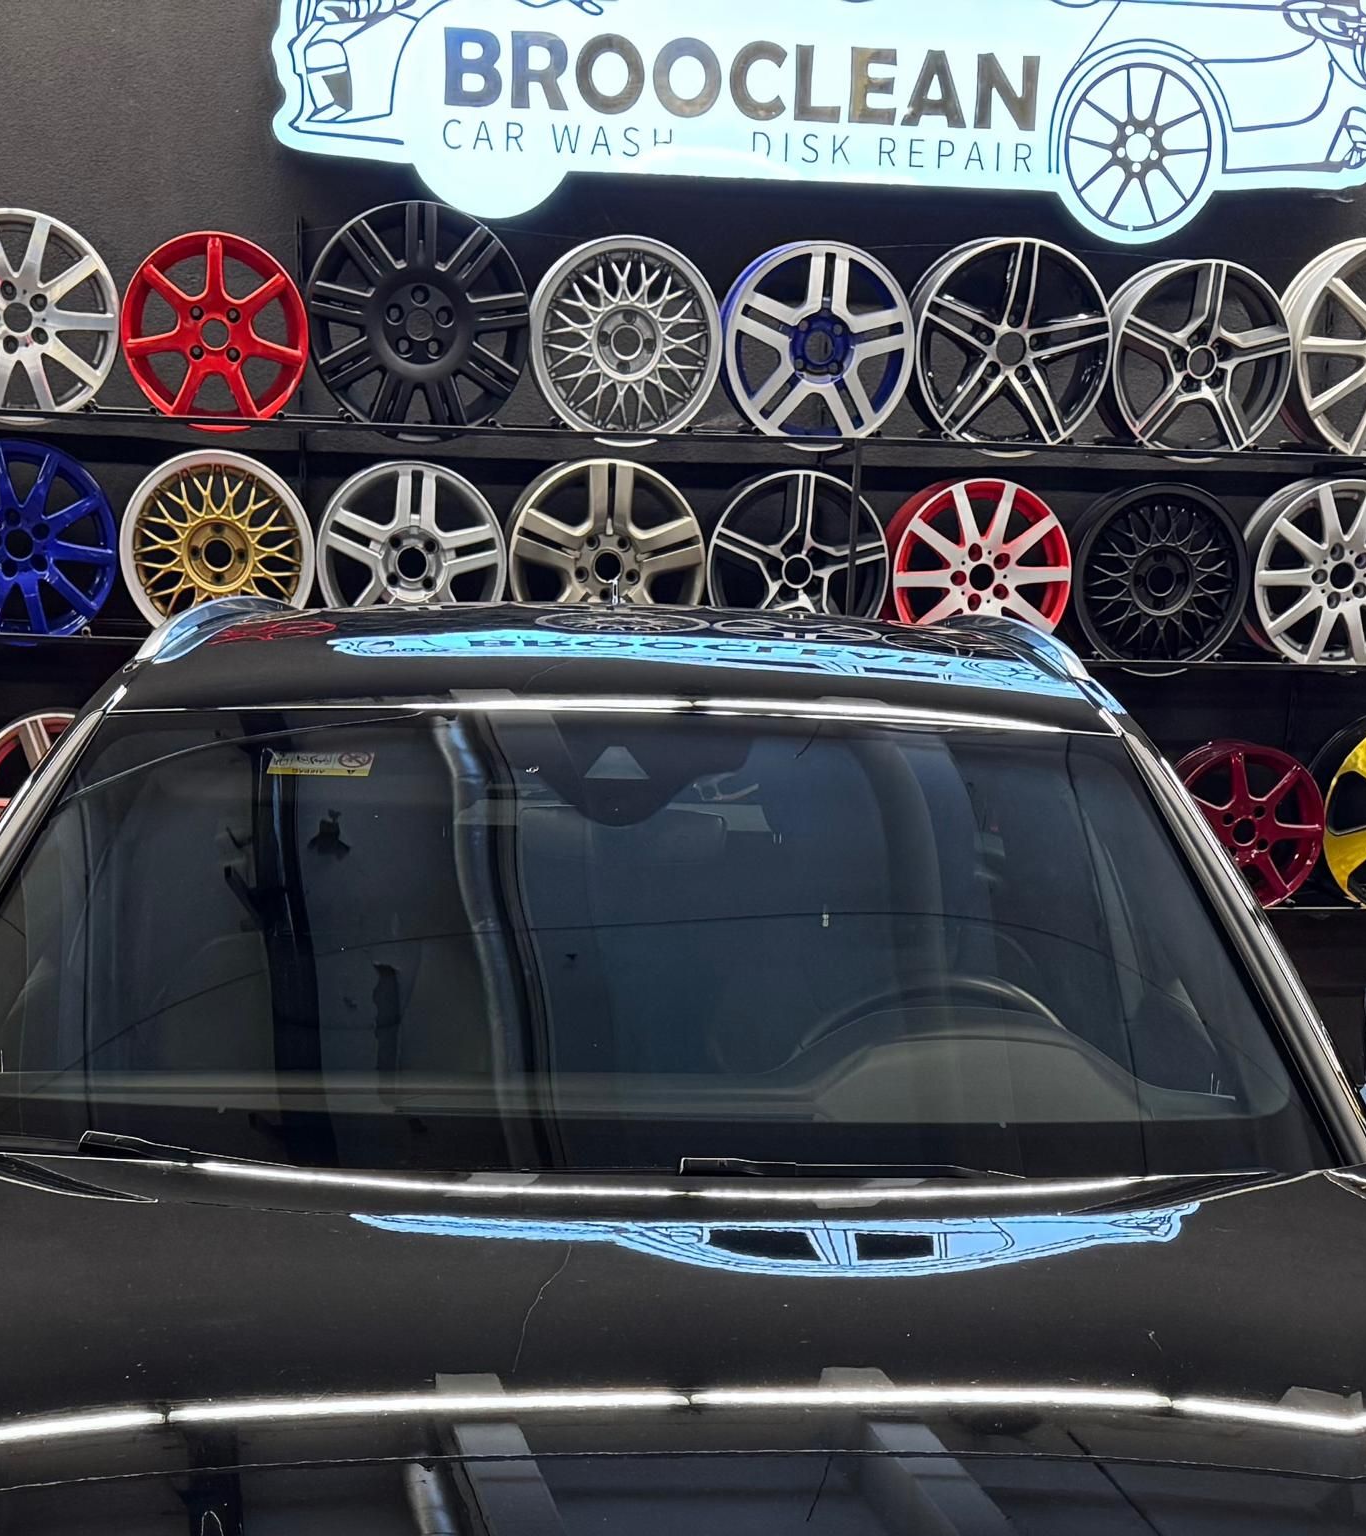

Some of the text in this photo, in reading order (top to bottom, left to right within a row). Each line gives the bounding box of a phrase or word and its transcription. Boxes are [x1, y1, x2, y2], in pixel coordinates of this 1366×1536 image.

[443, 26, 1041, 132] BROOCLEAN
[443, 118, 1032, 173] CAR WASH DISK REPAIR
